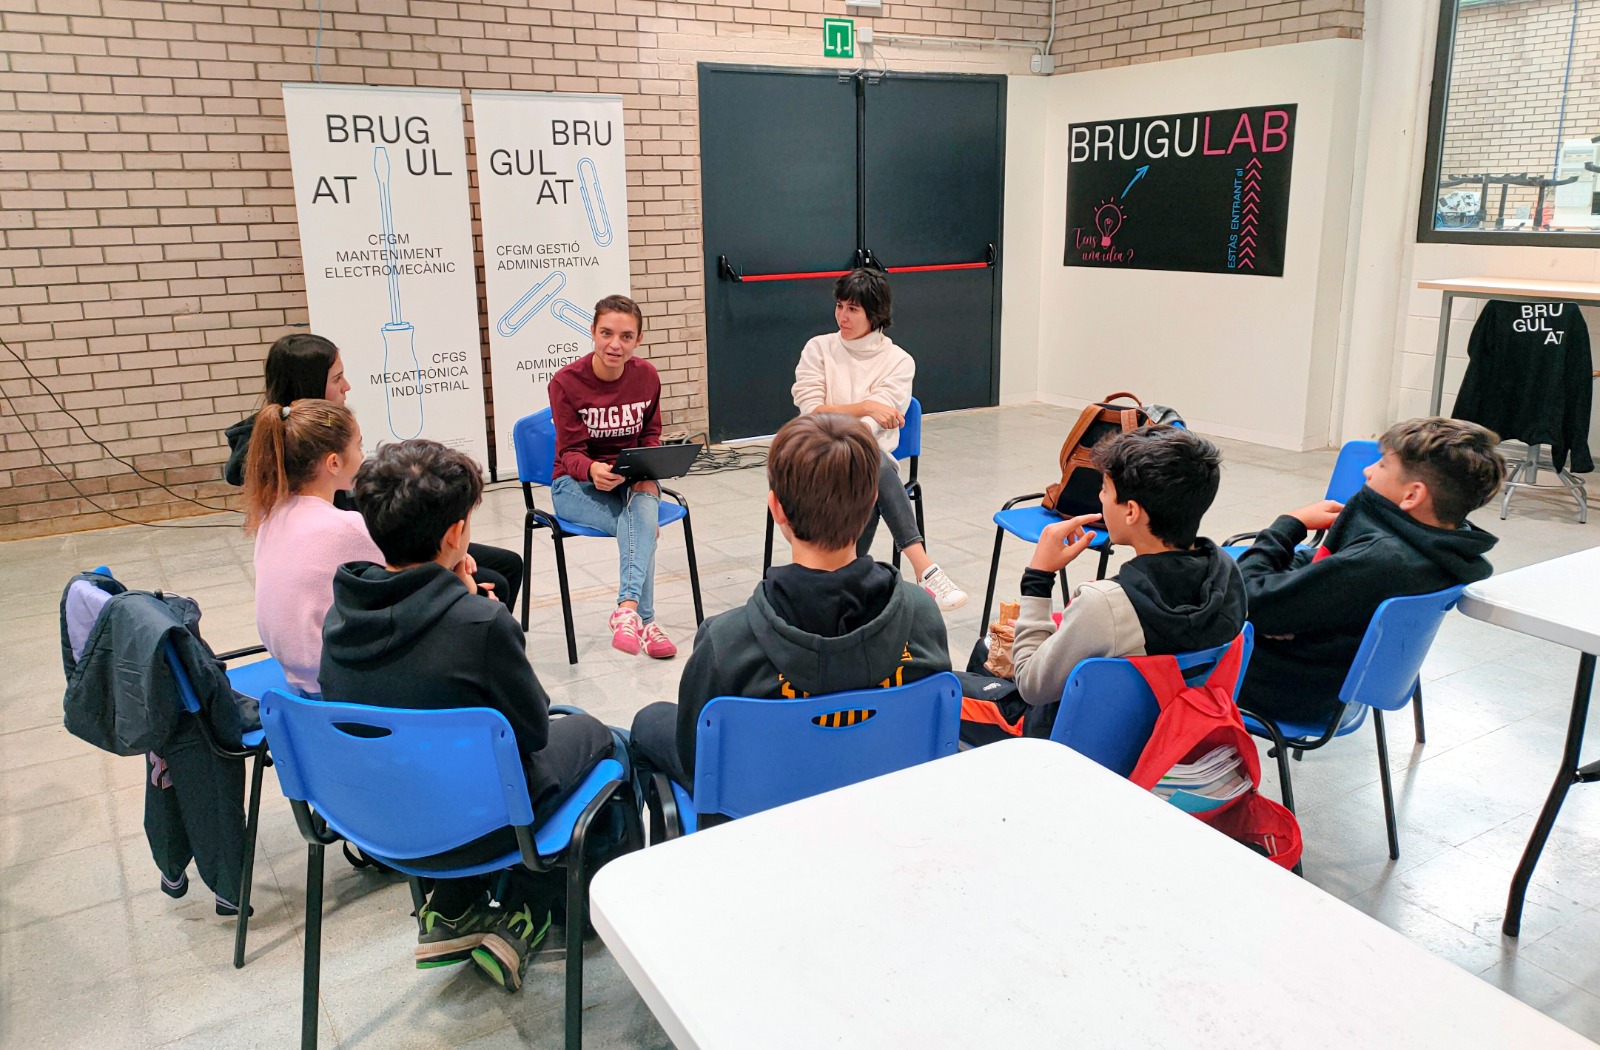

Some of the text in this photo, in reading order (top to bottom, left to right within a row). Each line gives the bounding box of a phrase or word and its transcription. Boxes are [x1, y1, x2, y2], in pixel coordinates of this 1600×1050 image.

[326, 114, 430, 144] BRUG
[551, 119, 612, 146] BRU
[1070, 110, 1289, 163] BRUGULAB
[405, 148, 452, 176] UL
[490, 149, 557, 176] GUL
[312, 176, 357, 204] AT
[536, 179, 574, 205] AT
[1231, 178, 1243, 230] ENTRANT
[368, 233, 410, 246] CFGM
[496, 240, 580, 256] CFGM GESTIÓ
[336, 247, 443, 263] MANTENIMENT
[497, 256, 600, 271] ADMINISTRATIVA
[325, 261, 456, 279] ELECTROMECÀNIC
[1521, 302, 1564, 319] BRU
[1512, 318, 1553, 332] GUL
[1543, 330, 1565, 345] AT
[547, 342, 579, 354] CFGS
[432, 351, 467, 364] CFGS
[370, 366, 469, 385] MECATRÒNICA
[391, 380, 470, 397] INDUSTRIAL
[577, 399, 652, 429] COLGAT
